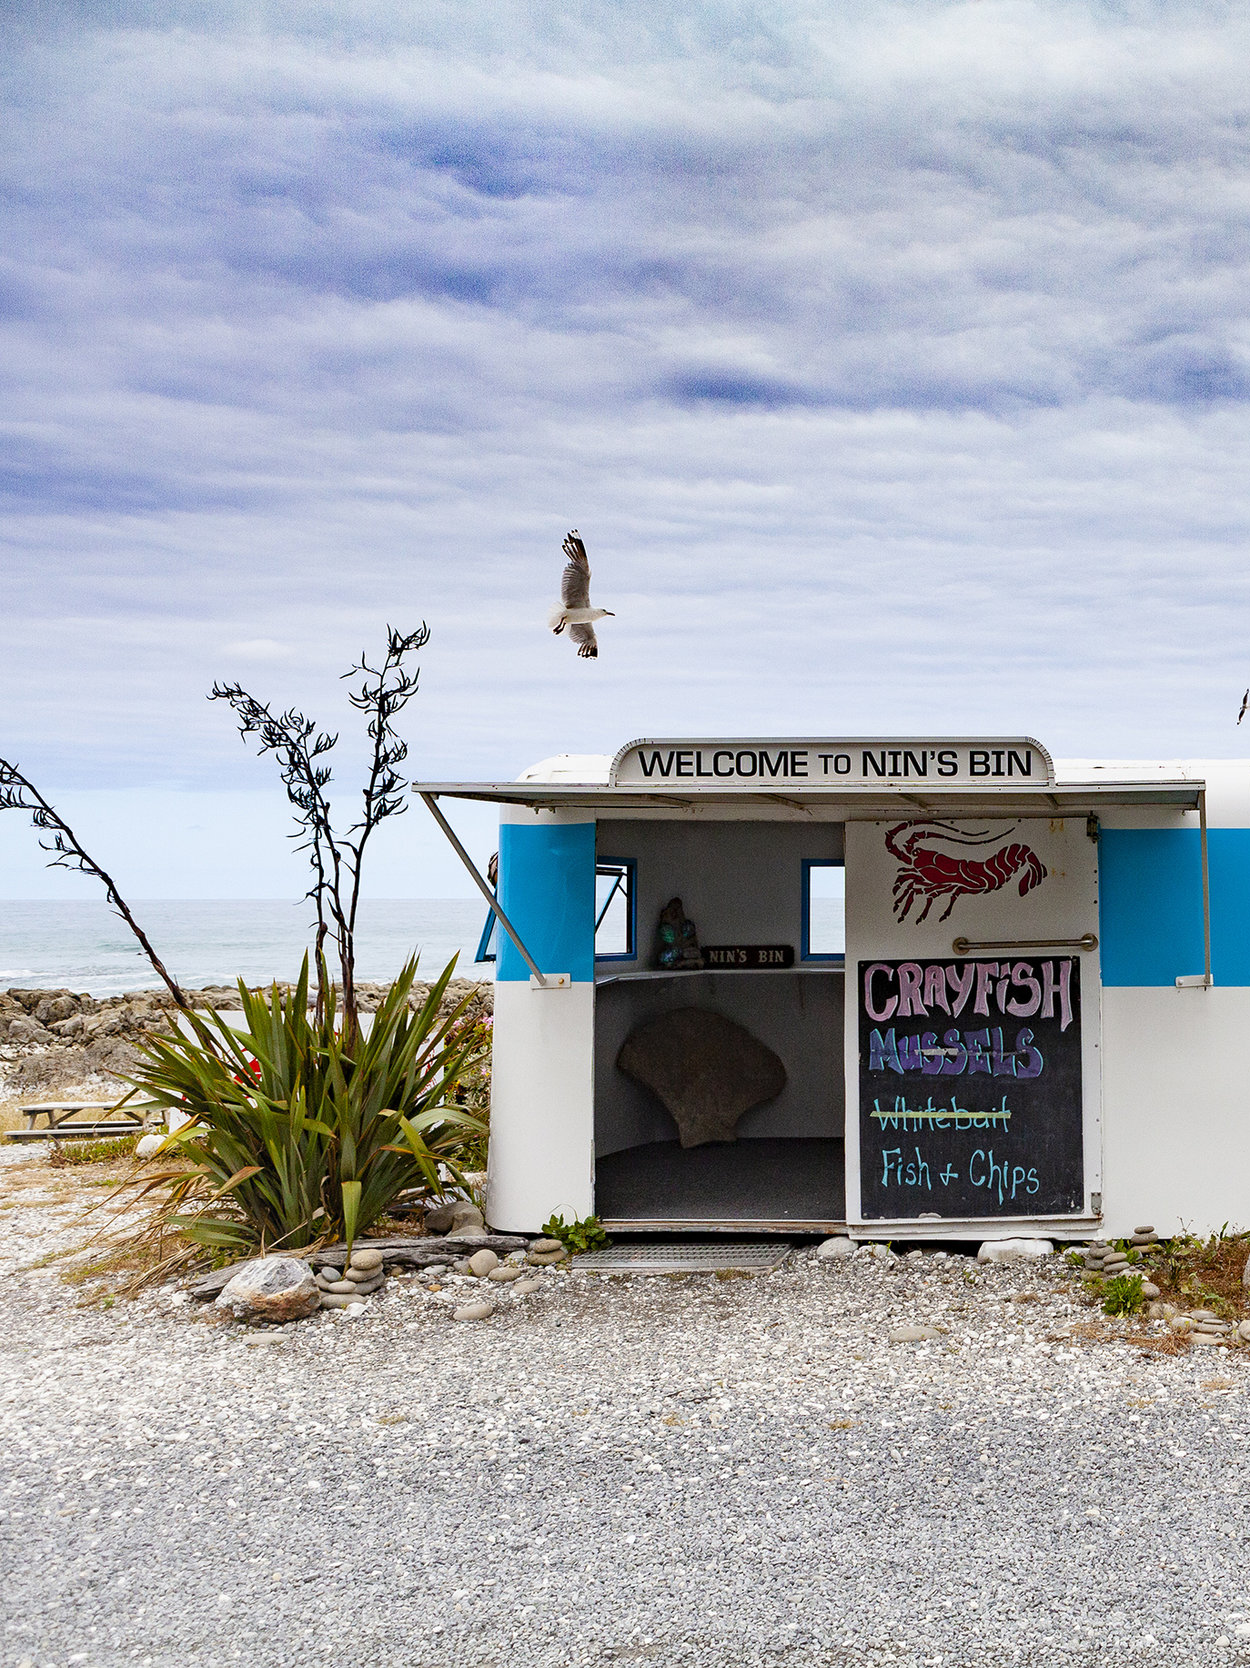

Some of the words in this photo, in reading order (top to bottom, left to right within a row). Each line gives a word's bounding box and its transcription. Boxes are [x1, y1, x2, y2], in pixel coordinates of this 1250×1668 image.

[638, 750, 809, 777] WELCOME
[818, 753, 851, 775] TO
[862, 750, 958, 777] NIN'S
[969, 750, 1032, 777] BIN
[709, 949, 747, 963] NIN'S
[758, 950, 784, 962] BIN
[869, 1026, 1044, 1079] MUSSELS
[873, 1095, 1012, 1133] Whitebait
[881, 1147, 932, 1190] Fish
[969, 1149, 1040, 1205] Chips
